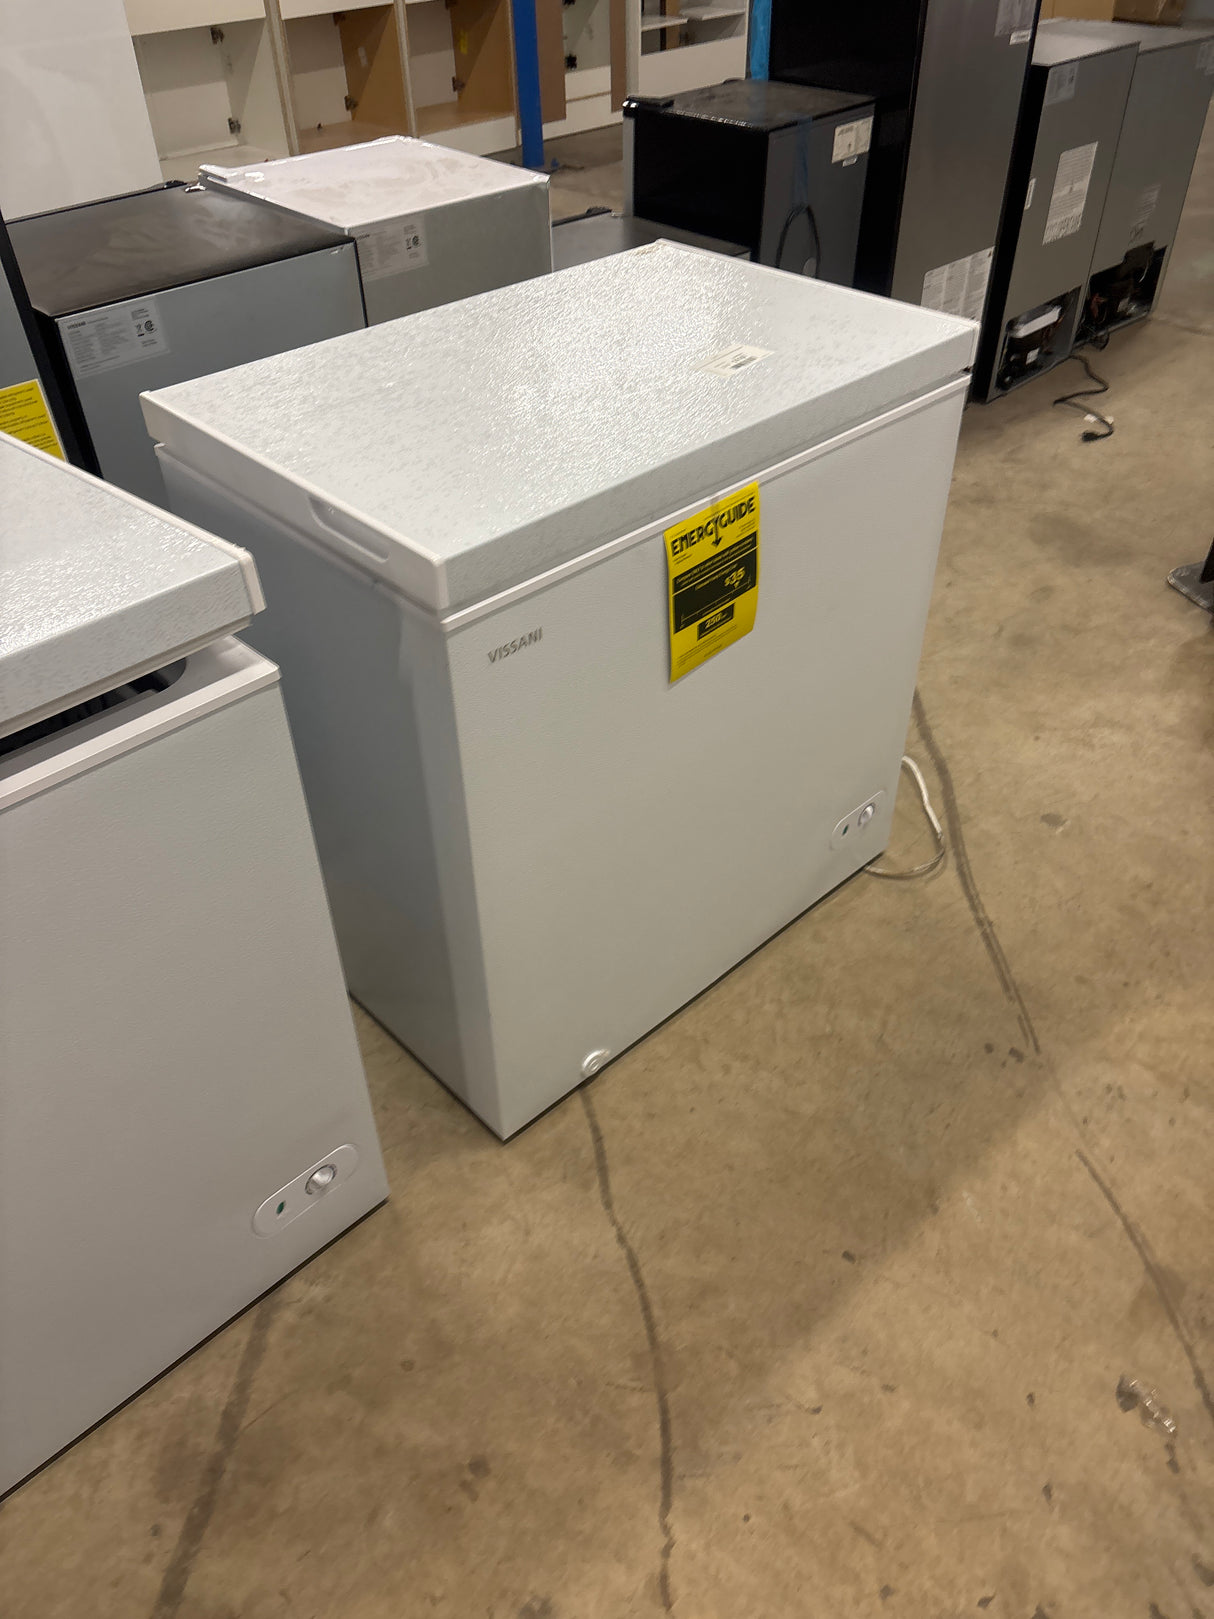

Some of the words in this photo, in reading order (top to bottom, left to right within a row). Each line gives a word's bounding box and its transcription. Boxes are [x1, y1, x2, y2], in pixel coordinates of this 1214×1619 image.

[671, 496, 756, 557] ENERGYGUIDE
[724, 567, 746, 587] $35
[488, 627, 543, 663] VISSANI
